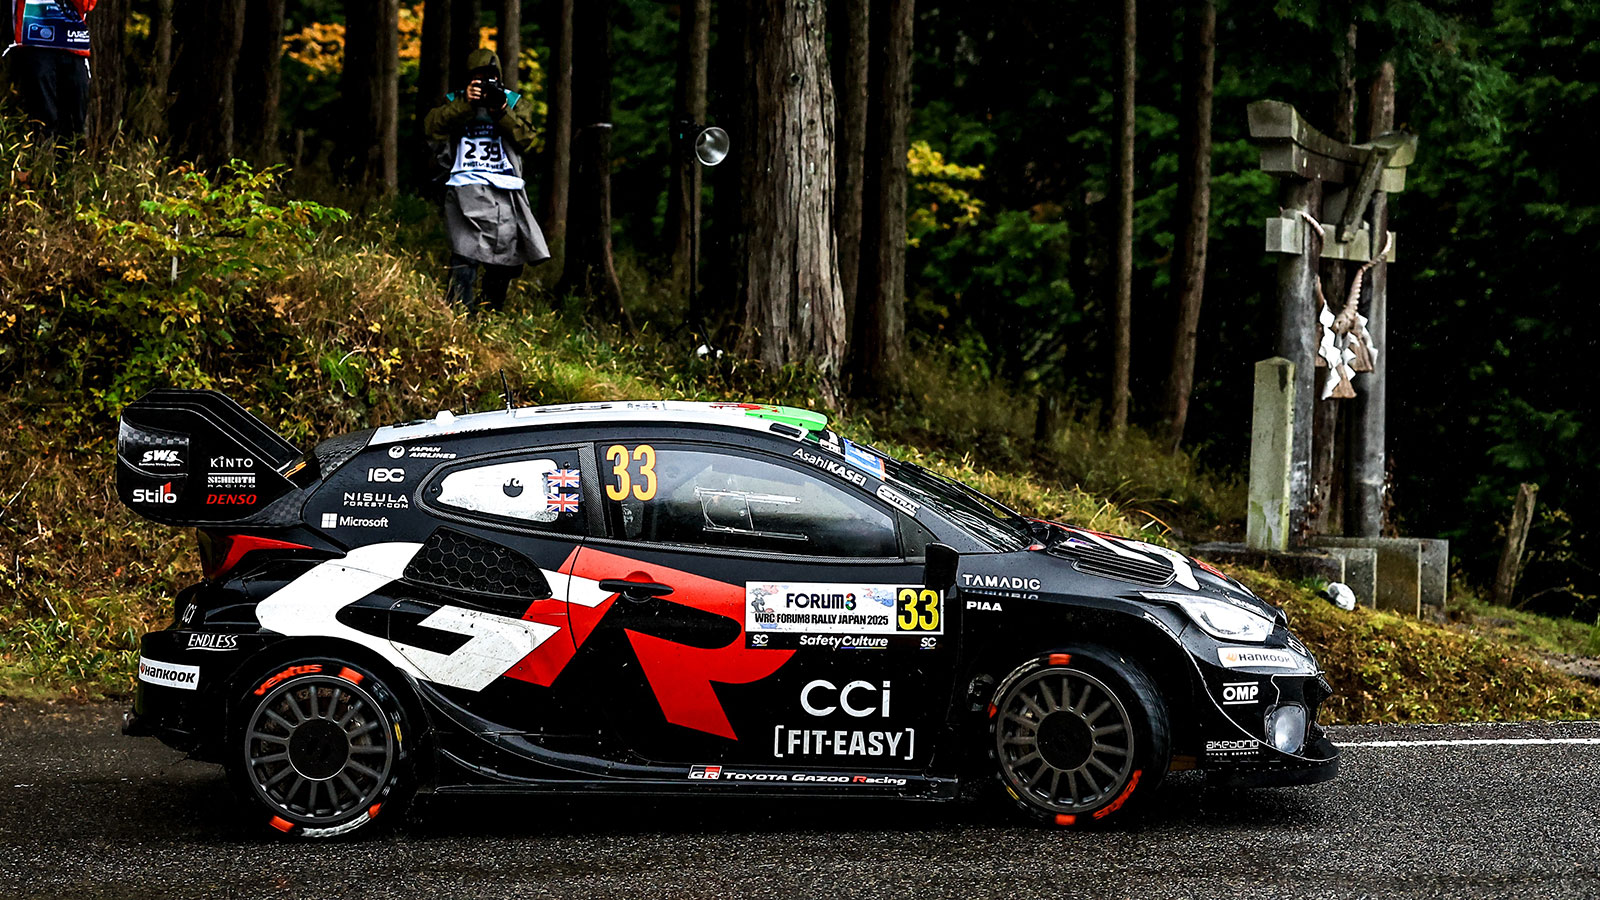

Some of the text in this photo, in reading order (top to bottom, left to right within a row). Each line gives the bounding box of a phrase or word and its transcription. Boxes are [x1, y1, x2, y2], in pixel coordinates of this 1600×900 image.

[464, 140, 502, 162] 239
[142, 449, 180, 463] SWS
[605, 444, 658, 501] 33
[132, 483, 178, 504] Stilo
[206, 493, 257, 505] DENSO
[343, 492, 409, 503] NISULA
[339, 516, 389, 528] Microsoft
[962, 574, 1041, 590] TAMADIC
[897, 588, 939, 631] 33
[966, 601, 1003, 611] PIAA
[754, 613, 889, 625] WRC FORUM8 RALLY JAPAN 2025
[187, 633, 239, 648] ENDLESS
[752, 634, 769, 645] SC
[799, 634, 889, 648] SafetyCulture
[920, 637, 937, 647] SC
[1222, 685, 1259, 701] OMP
[1206, 739, 1260, 749] akebono
[852, 775, 907, 786] Racing
